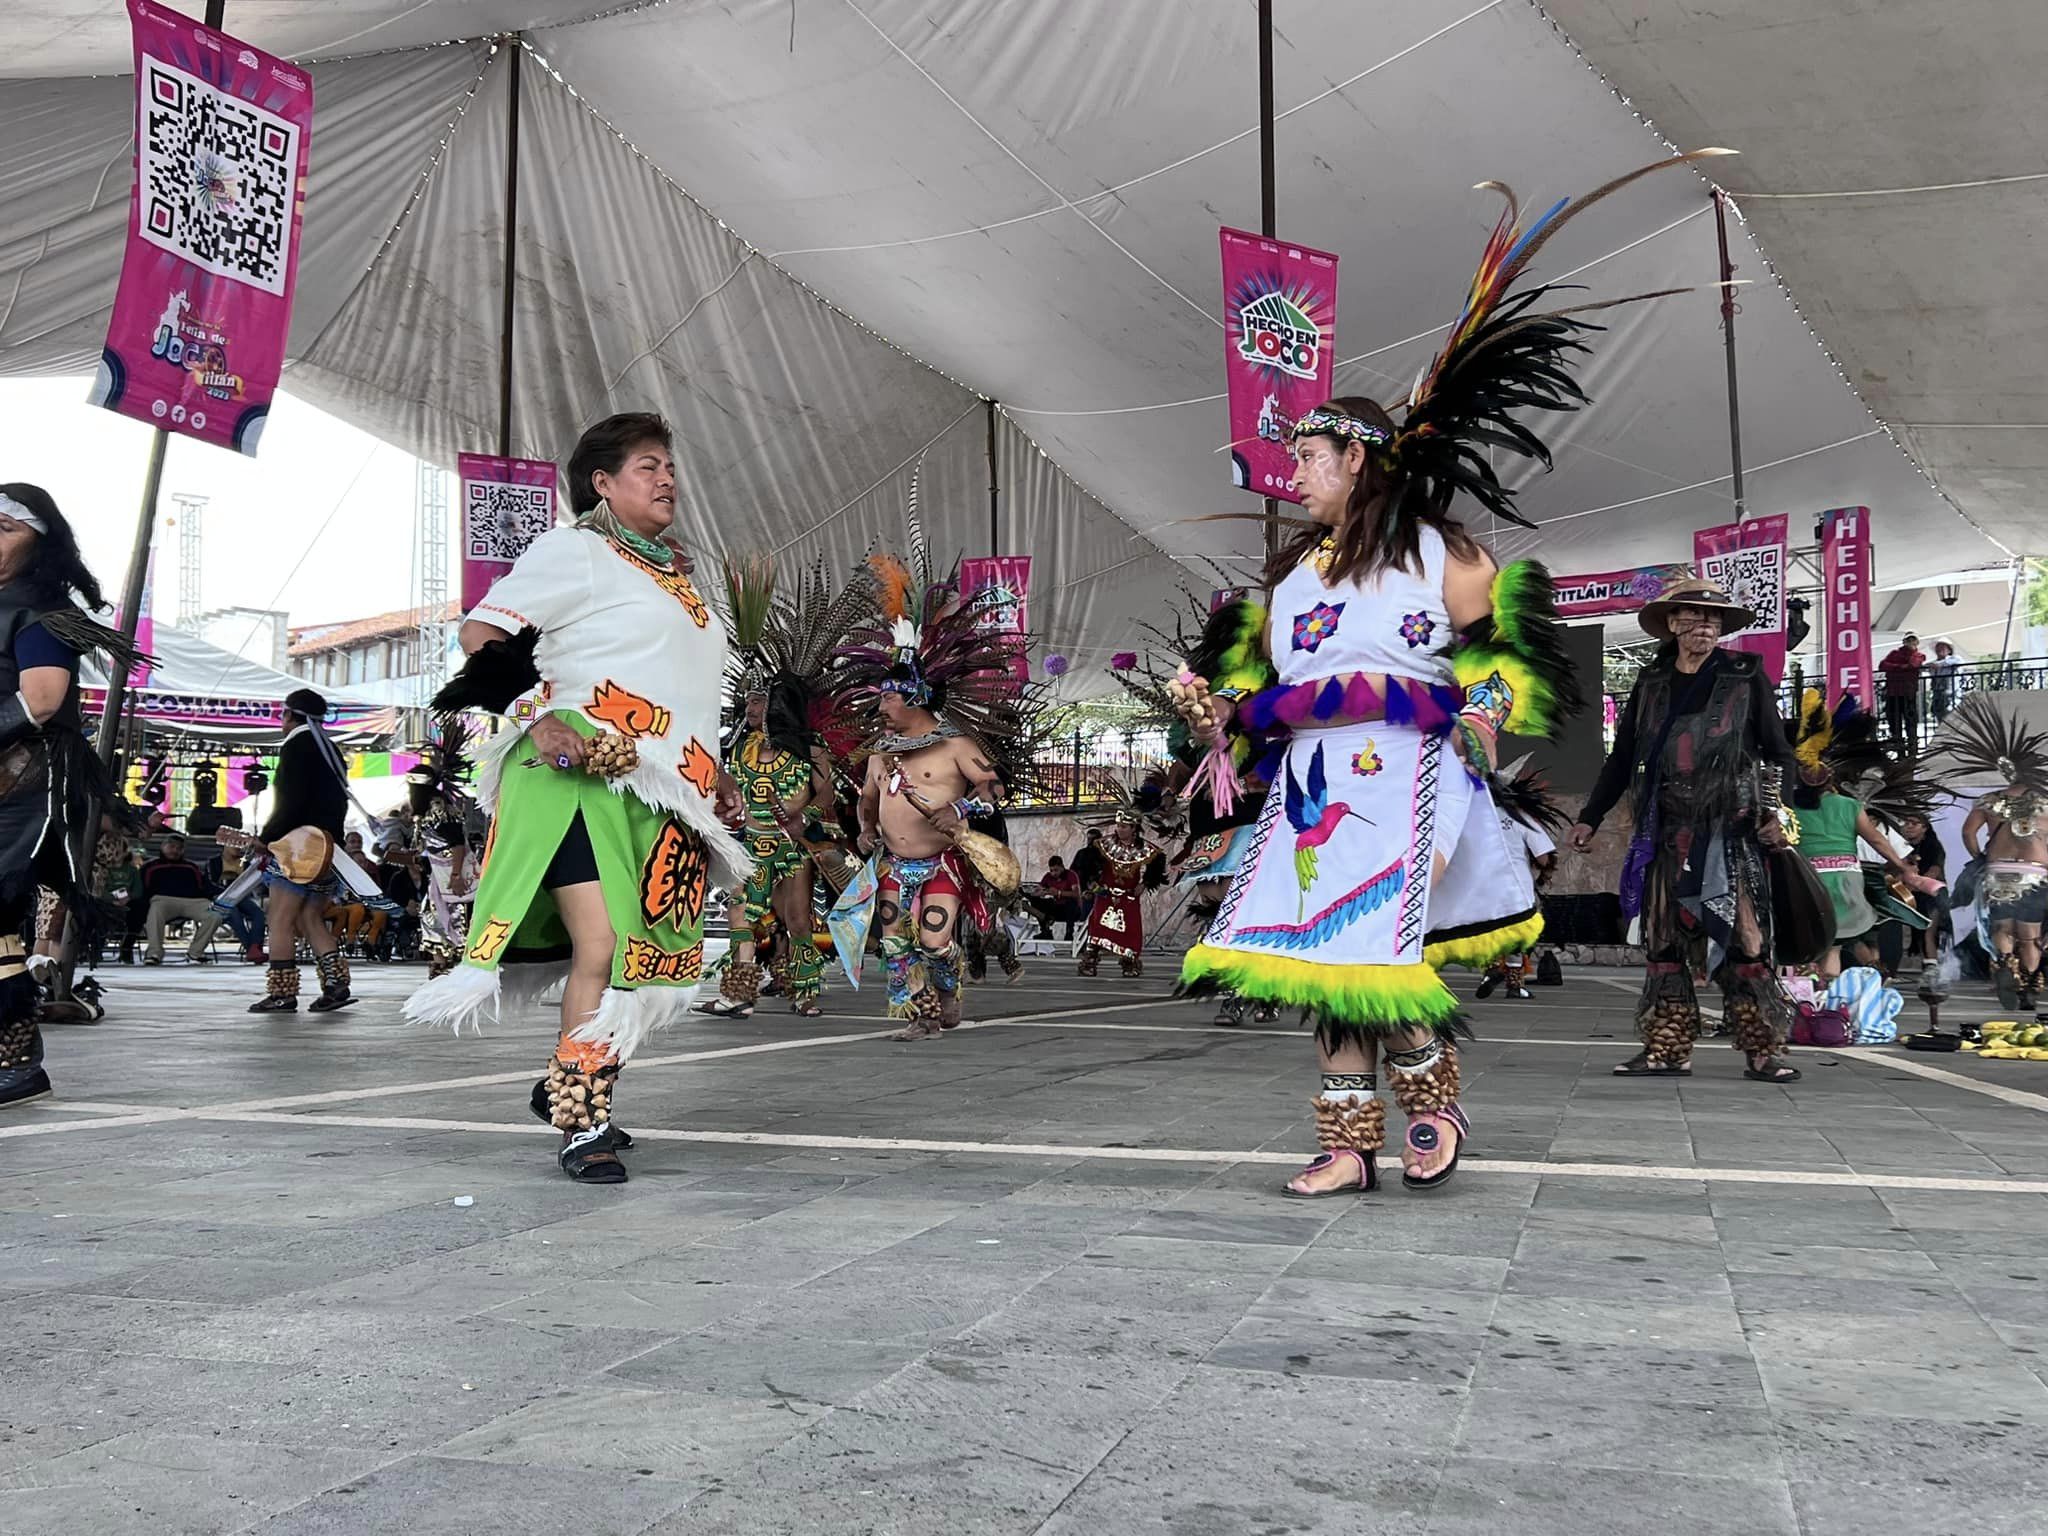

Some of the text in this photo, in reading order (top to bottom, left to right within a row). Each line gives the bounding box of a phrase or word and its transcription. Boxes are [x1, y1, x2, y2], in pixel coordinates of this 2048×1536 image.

[211, 333, 226, 345] de
[1245, 315, 1317, 346] HECHO EN
[1241, 329, 1315, 370] JOCO
[1553, 581, 1634, 605] TITLÁN 20
[1835, 517, 1860, 652] HECHO
[1840, 666, 1861, 706] E
